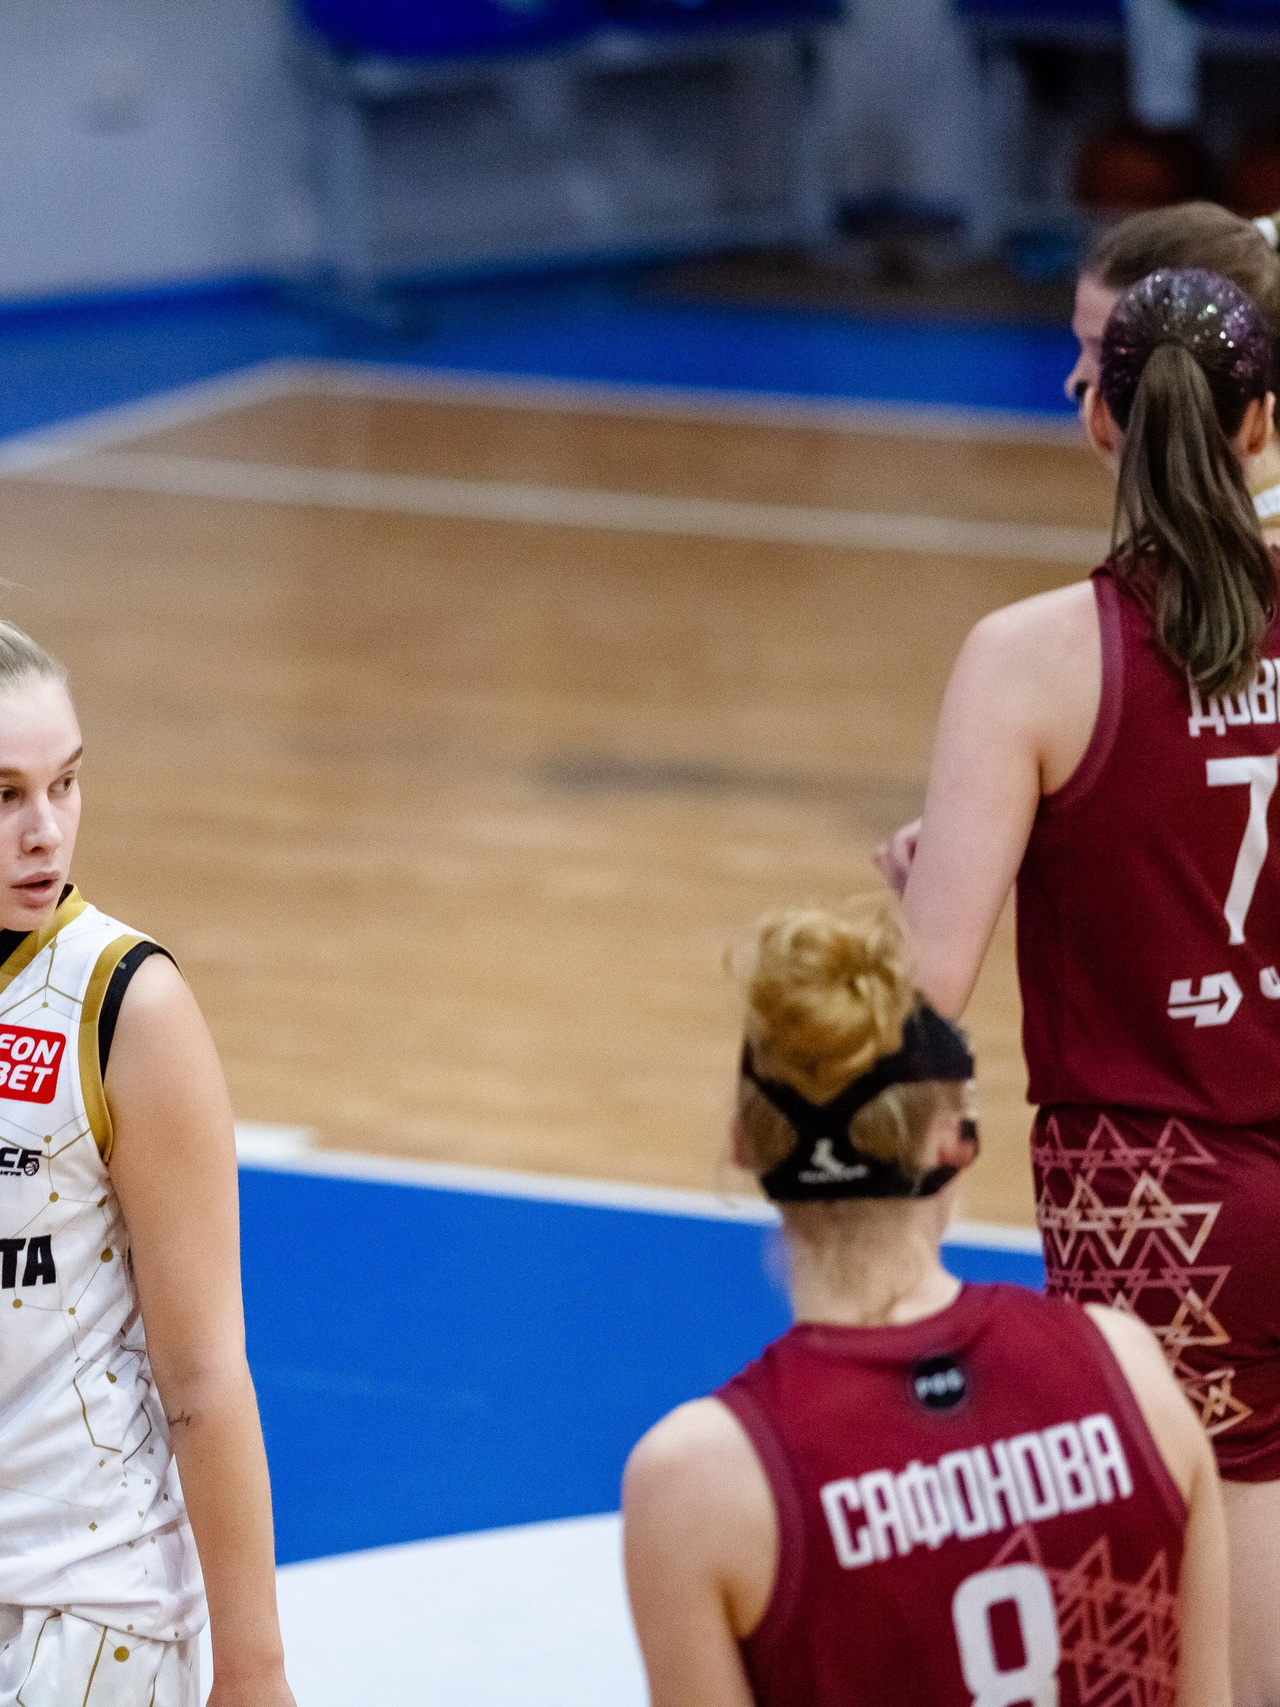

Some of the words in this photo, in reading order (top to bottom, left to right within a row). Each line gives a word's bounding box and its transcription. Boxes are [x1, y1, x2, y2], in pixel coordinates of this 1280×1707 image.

[1206, 755, 1279, 945] 7
[821, 1413, 1133, 1569] САФОНОВА
[951, 1561, 1060, 1707] 8
